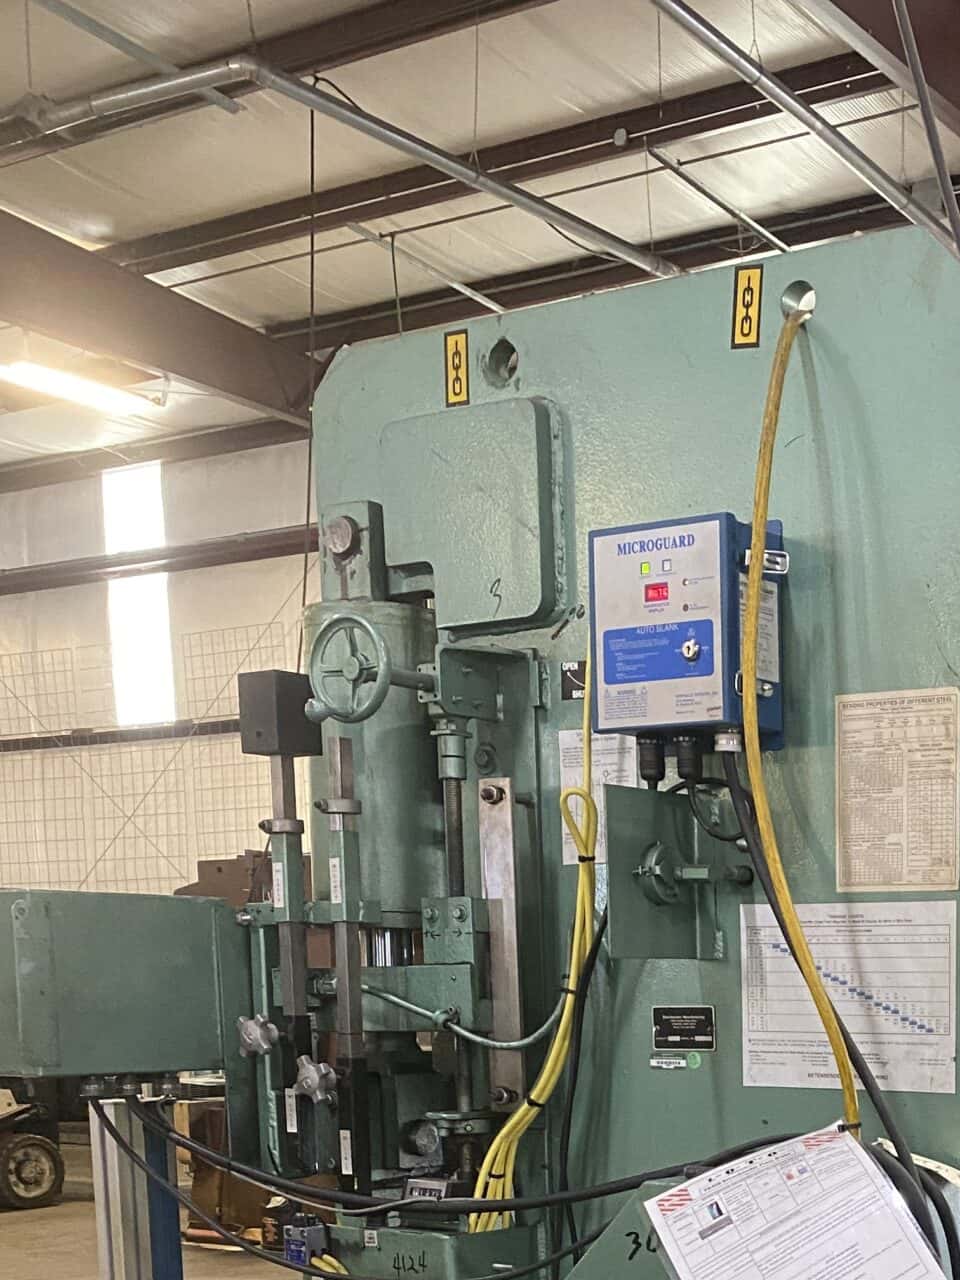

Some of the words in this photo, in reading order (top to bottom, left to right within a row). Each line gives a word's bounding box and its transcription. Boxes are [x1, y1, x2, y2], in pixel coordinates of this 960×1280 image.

[617, 533, 695, 556] MICROGUARD
[636, 625, 655, 635] AUTO
[656, 623, 680, 633] BLANK
[392, 1250, 428, 1277] 4124
